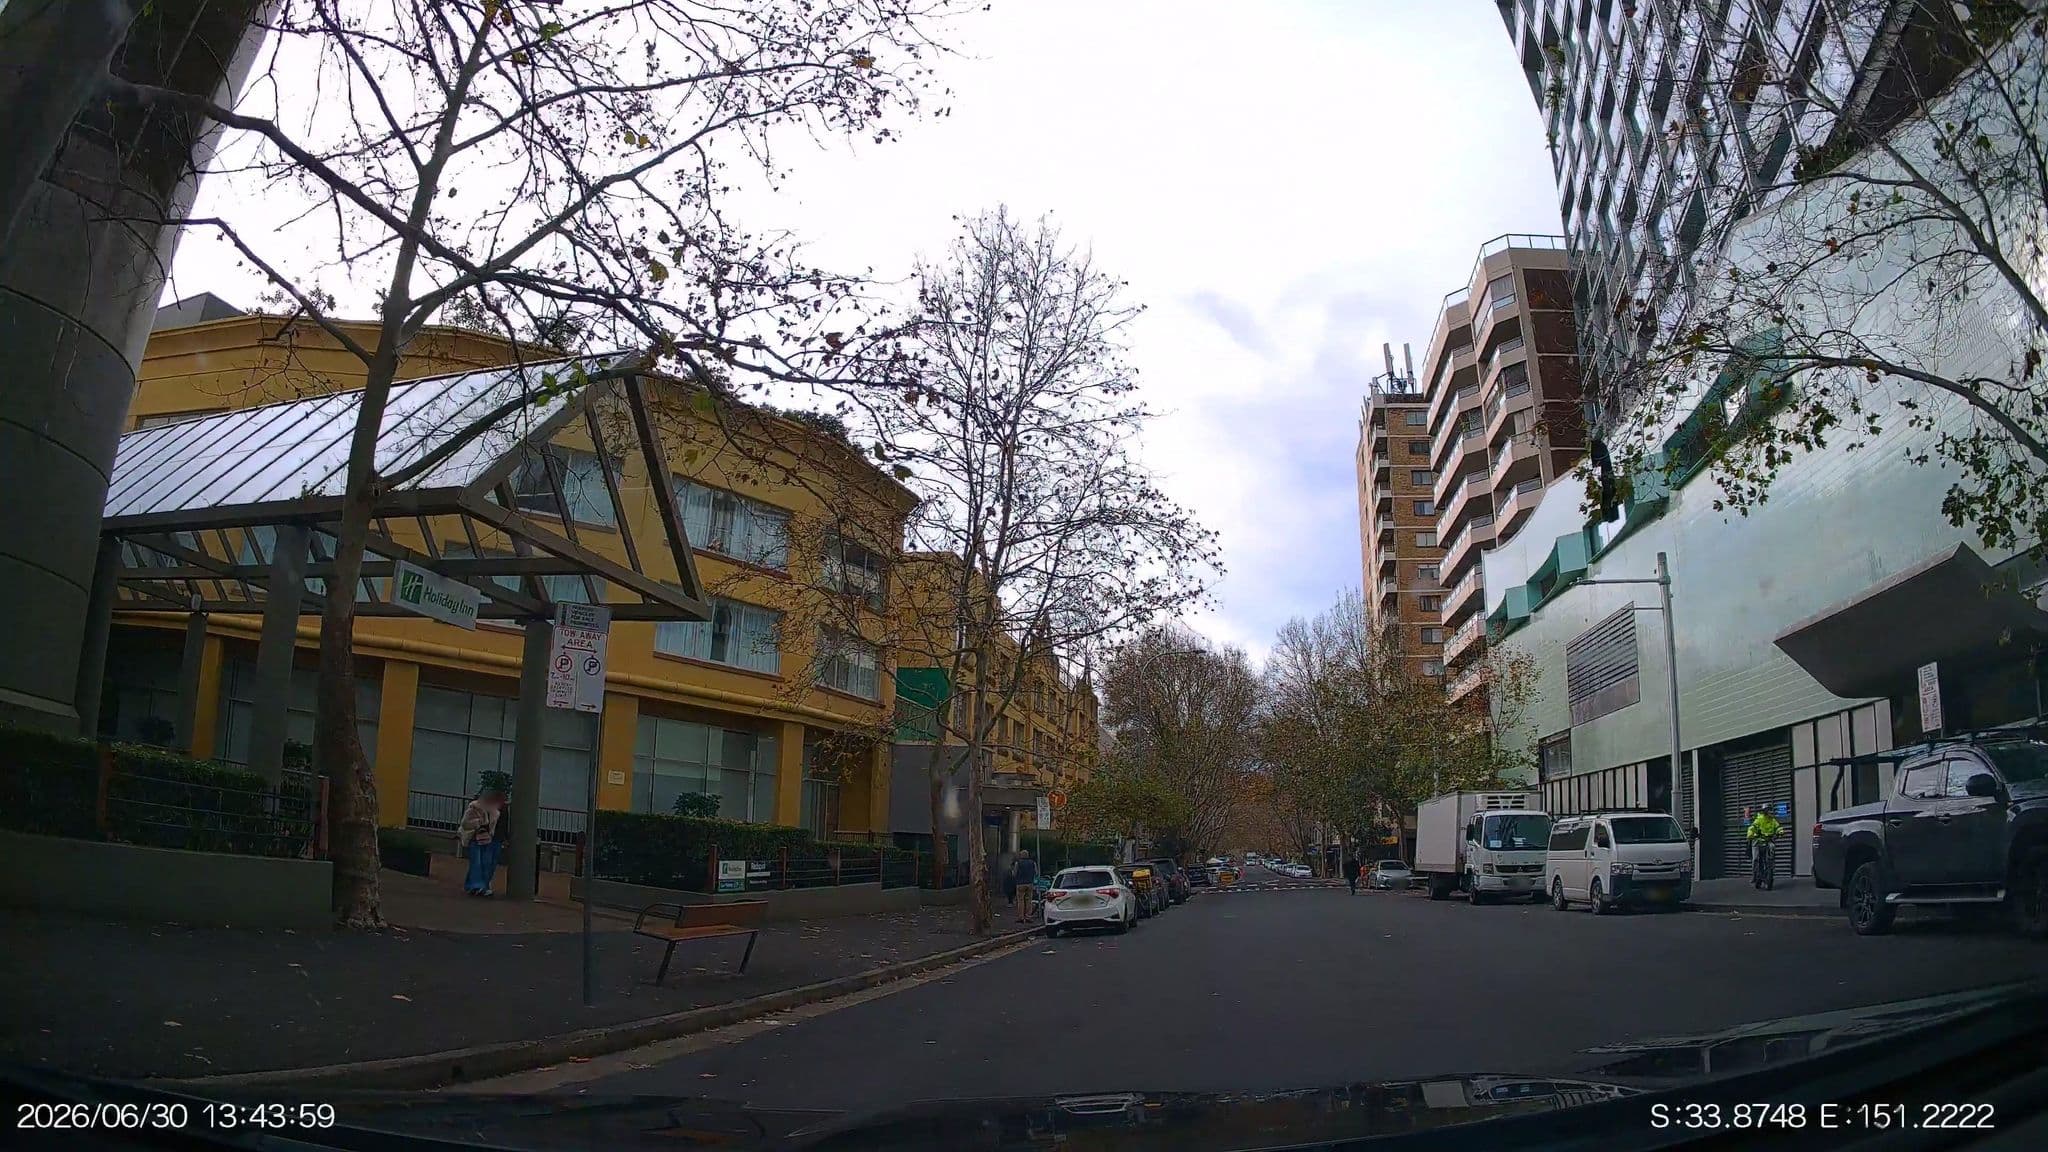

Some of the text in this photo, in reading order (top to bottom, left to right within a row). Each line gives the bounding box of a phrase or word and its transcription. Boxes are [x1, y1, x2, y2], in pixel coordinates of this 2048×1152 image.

[424, 585, 474, 617] Holiday Inn
[559, 629, 602, 641] TOW AWAY
[567, 639, 593, 649] AREA
